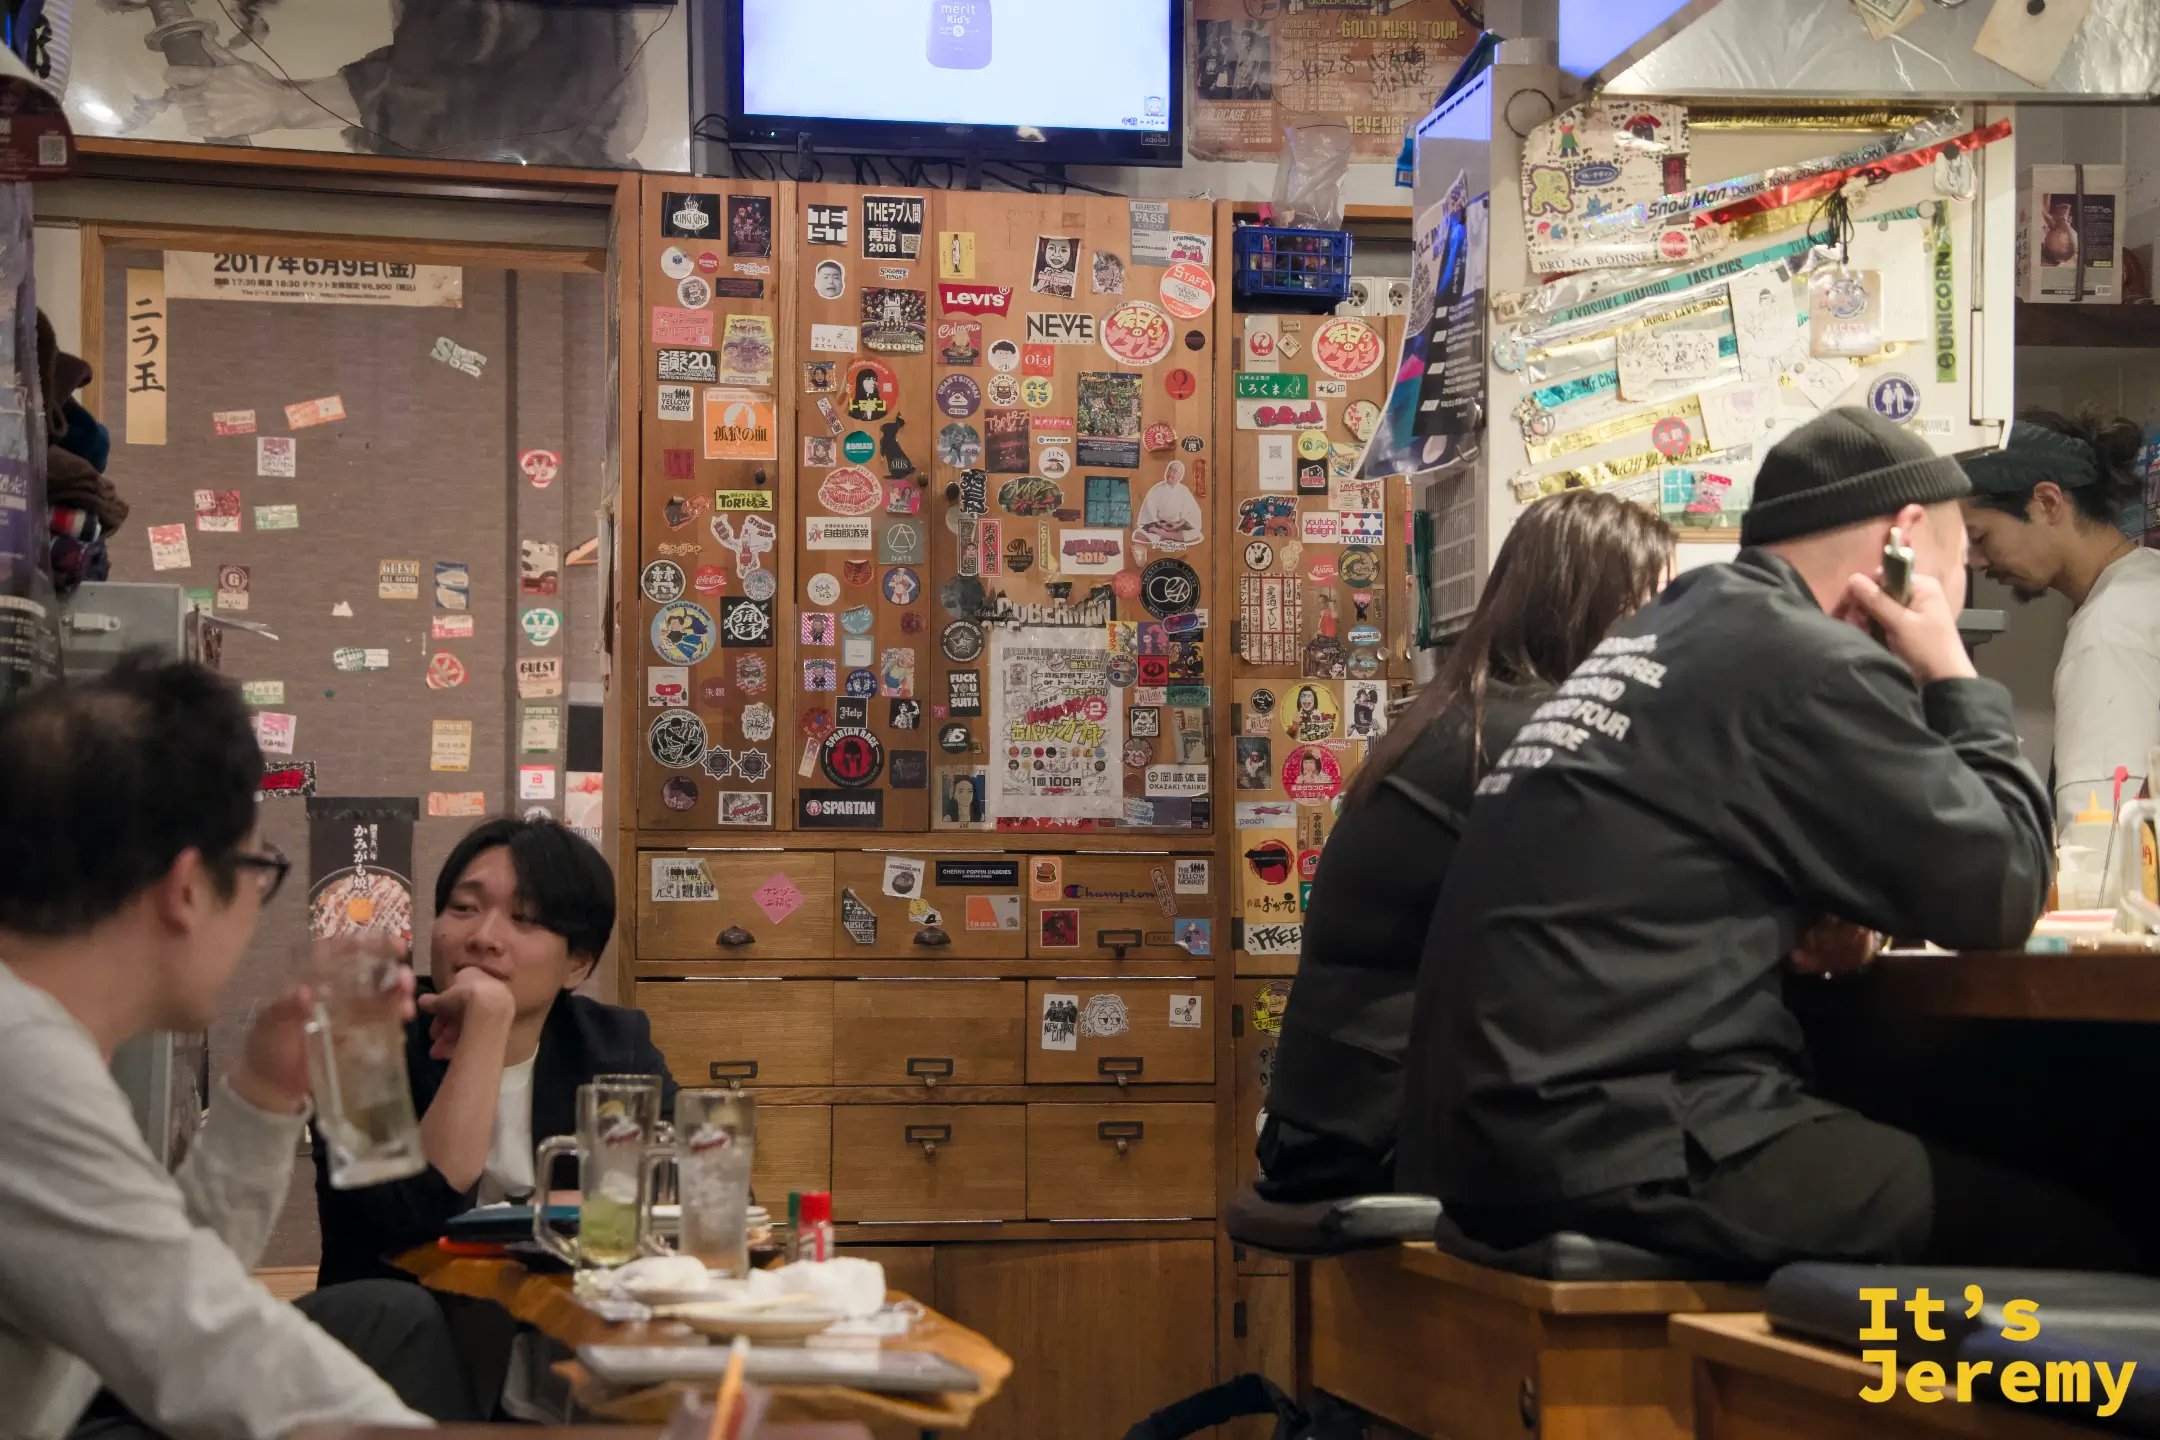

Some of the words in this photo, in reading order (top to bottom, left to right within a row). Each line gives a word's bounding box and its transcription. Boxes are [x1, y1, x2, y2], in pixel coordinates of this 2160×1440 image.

[941, 4, 976, 14] merit
[947, 15, 970, 24] Kid's
[1381, 20, 1418, 39] RUSH
[867, 202, 921, 224] THEラブ人間
[1135, 203, 1161, 212] GUEST
[675, 212, 692, 224] KING
[693, 211, 709, 224] GNU
[1134, 212, 1165, 224] PASS
[868, 228, 897, 242] 再訪
[868, 242, 897, 253] 2018
[1572, 257, 1590, 267] NA
[1172, 264, 1209, 290] STAFF
[1935, 250, 1955, 352] UNICORN
[128, 298, 167, 395] ニラ玉
[1239, 382, 1280, 396] しろくま
[661, 392, 674, 400] THE
[1047, 450, 1064, 458] JIN
[1305, 518, 1337, 529] youtube
[823, 528, 870, 539] 自由飲酒党
[1305, 524, 1337, 537] delight
[1341, 536, 1382, 545] TOMITA
[382, 563, 417, 574] GUEST
[519, 660, 556, 674] GUEST
[950, 673, 978, 683] FUCK
[951, 697, 980, 708] SUITA
[839, 706, 863, 720] Help
[1088, 702, 1103, 716] 2
[1573, 700, 1632, 742] FOUR
[826, 728, 857, 748] SPARTAN
[856, 728, 880, 749] RACE
[1032, 776, 1046, 787] 1回
[1048, 776, 1082, 787] 100円
[822, 802, 876, 815] SPARTAN
[1238, 816, 1265, 826] peach
[353, 824, 369, 892] かみがも焼
